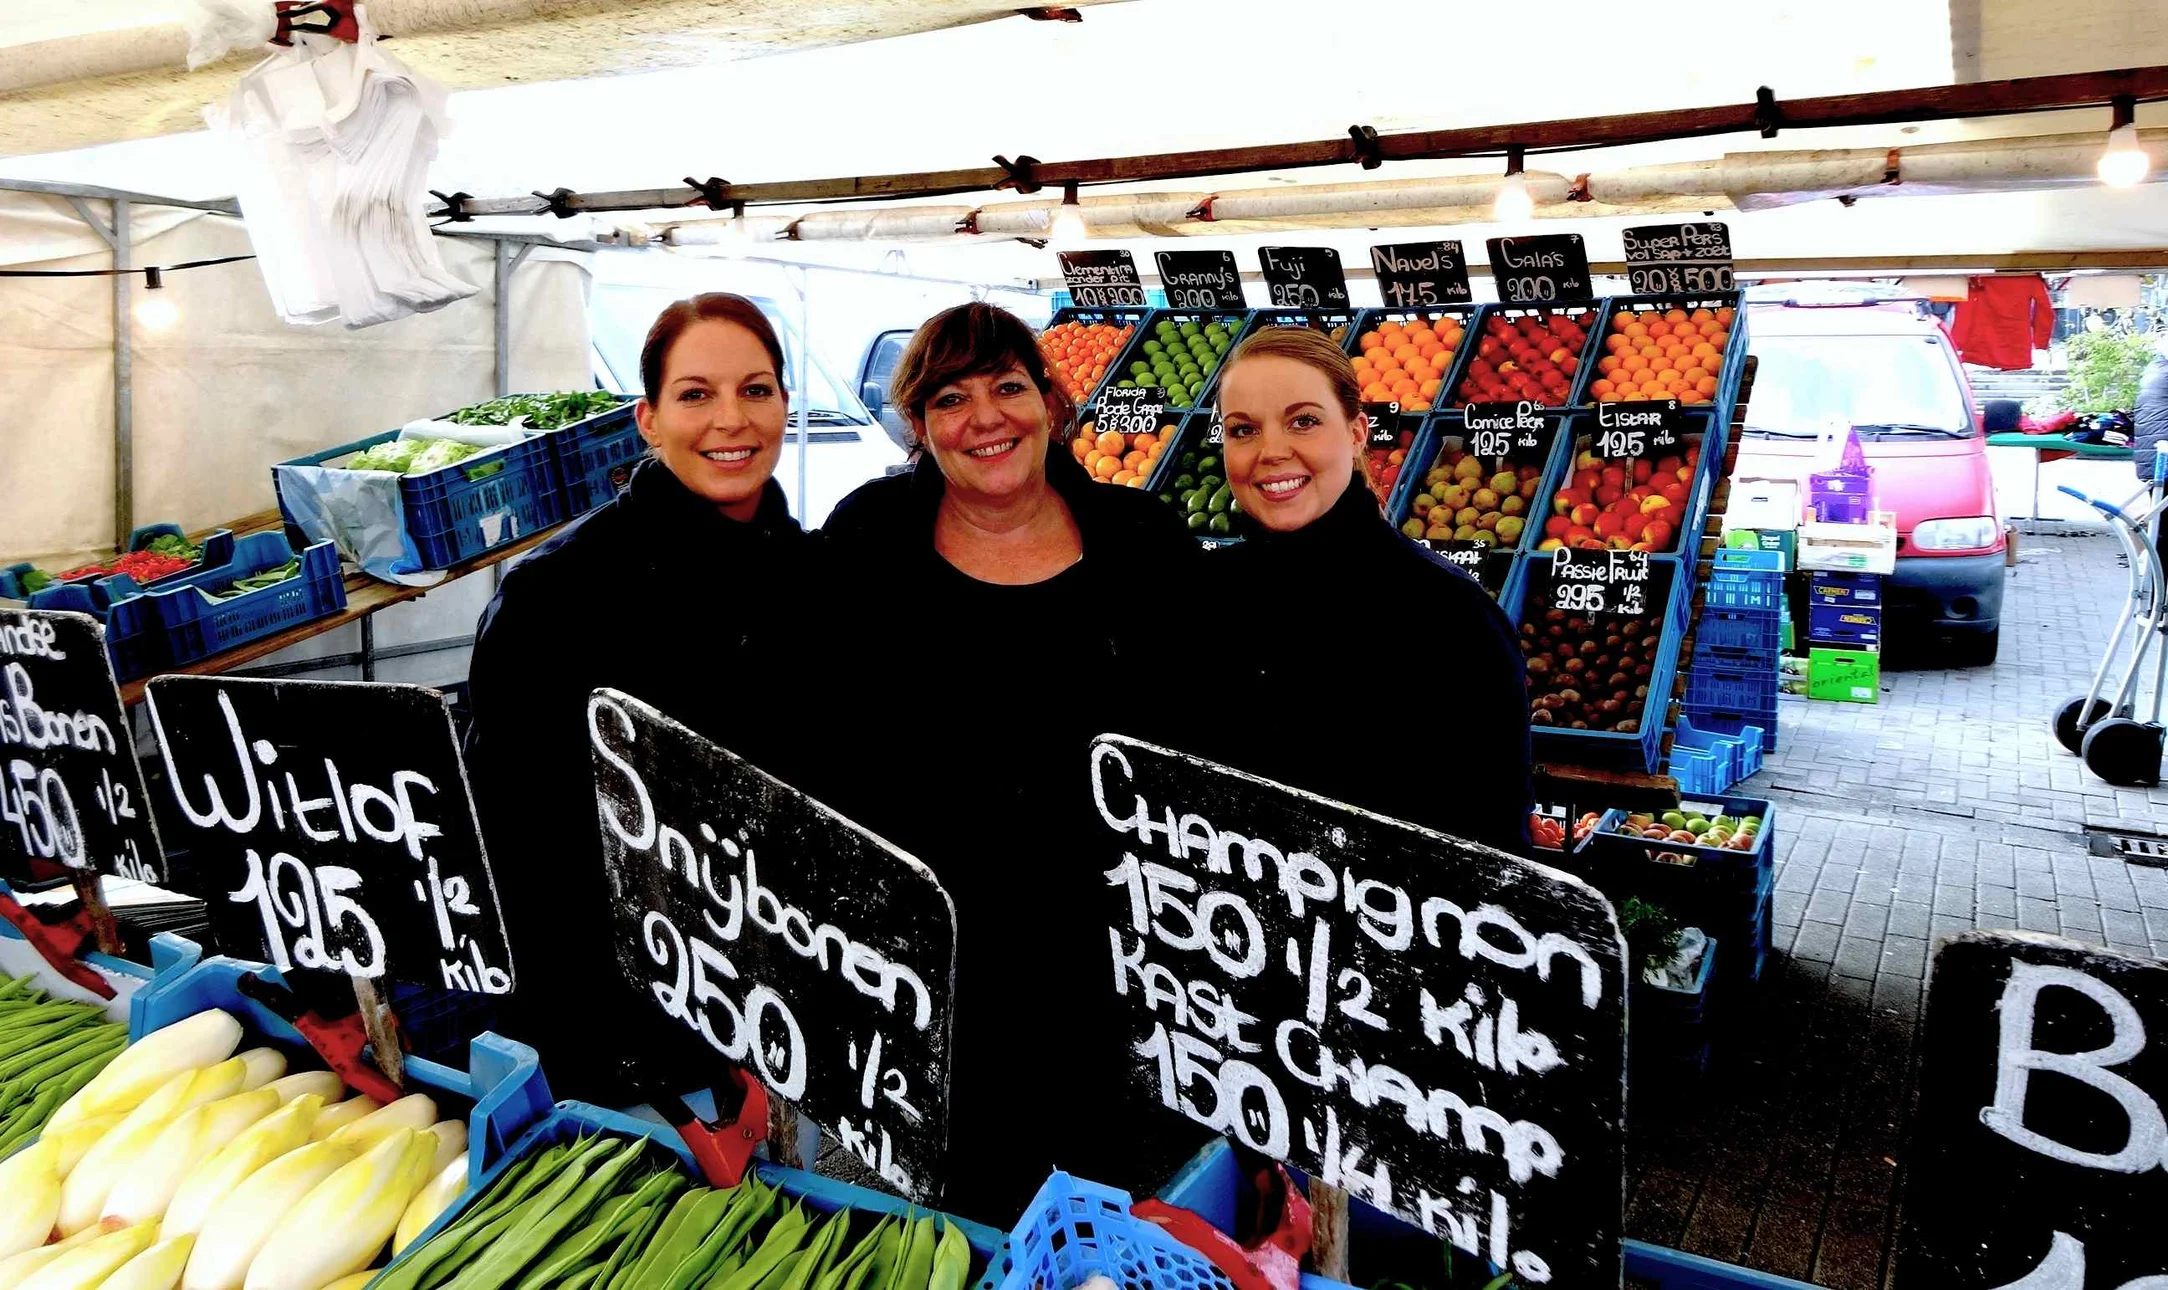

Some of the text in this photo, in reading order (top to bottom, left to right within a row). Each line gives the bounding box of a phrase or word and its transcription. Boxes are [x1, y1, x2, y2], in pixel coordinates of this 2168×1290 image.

[1222, 252, 1231, 262] 6
[1265, 247, 1306, 280] Fuji
[1507, 276, 1556, 302] 200
[1633, 269, 1667, 294] 20
[1684, 266, 1734, 293] 500
[1075, 287, 1099, 306] 10
[1107, 287, 1145, 305] 200
[1174, 289, 1216, 308] 200
[1273, 284, 1320, 307] 250
[1095, 396, 1131, 415] Rode
[1389, 401, 1399, 414] 9
[1464, 403, 1515, 430] Comice
[1668, 400, 1676, 410] 8
[1095, 414, 1108, 433] 5
[1119, 415, 1157, 433] 300
[1470, 430, 1512, 456] 125
[1596, 430, 1646, 457] 125
[1555, 584, 1605, 611] 295
[1623, 583, 1642, 602] 1/2
[1812, 664, 1875, 688] oriental
[146, 686, 443, 860] Witlof
[0, 759, 137, 870] 450 1/2
[228, 849, 480, 978] 125 1/2
[1104, 851, 1266, 978] 150
[1286, 916, 1389, 1032] 1/2
[643, 910, 924, 1123] 250 1/2
[1134, 1021, 1290, 1161] 150
